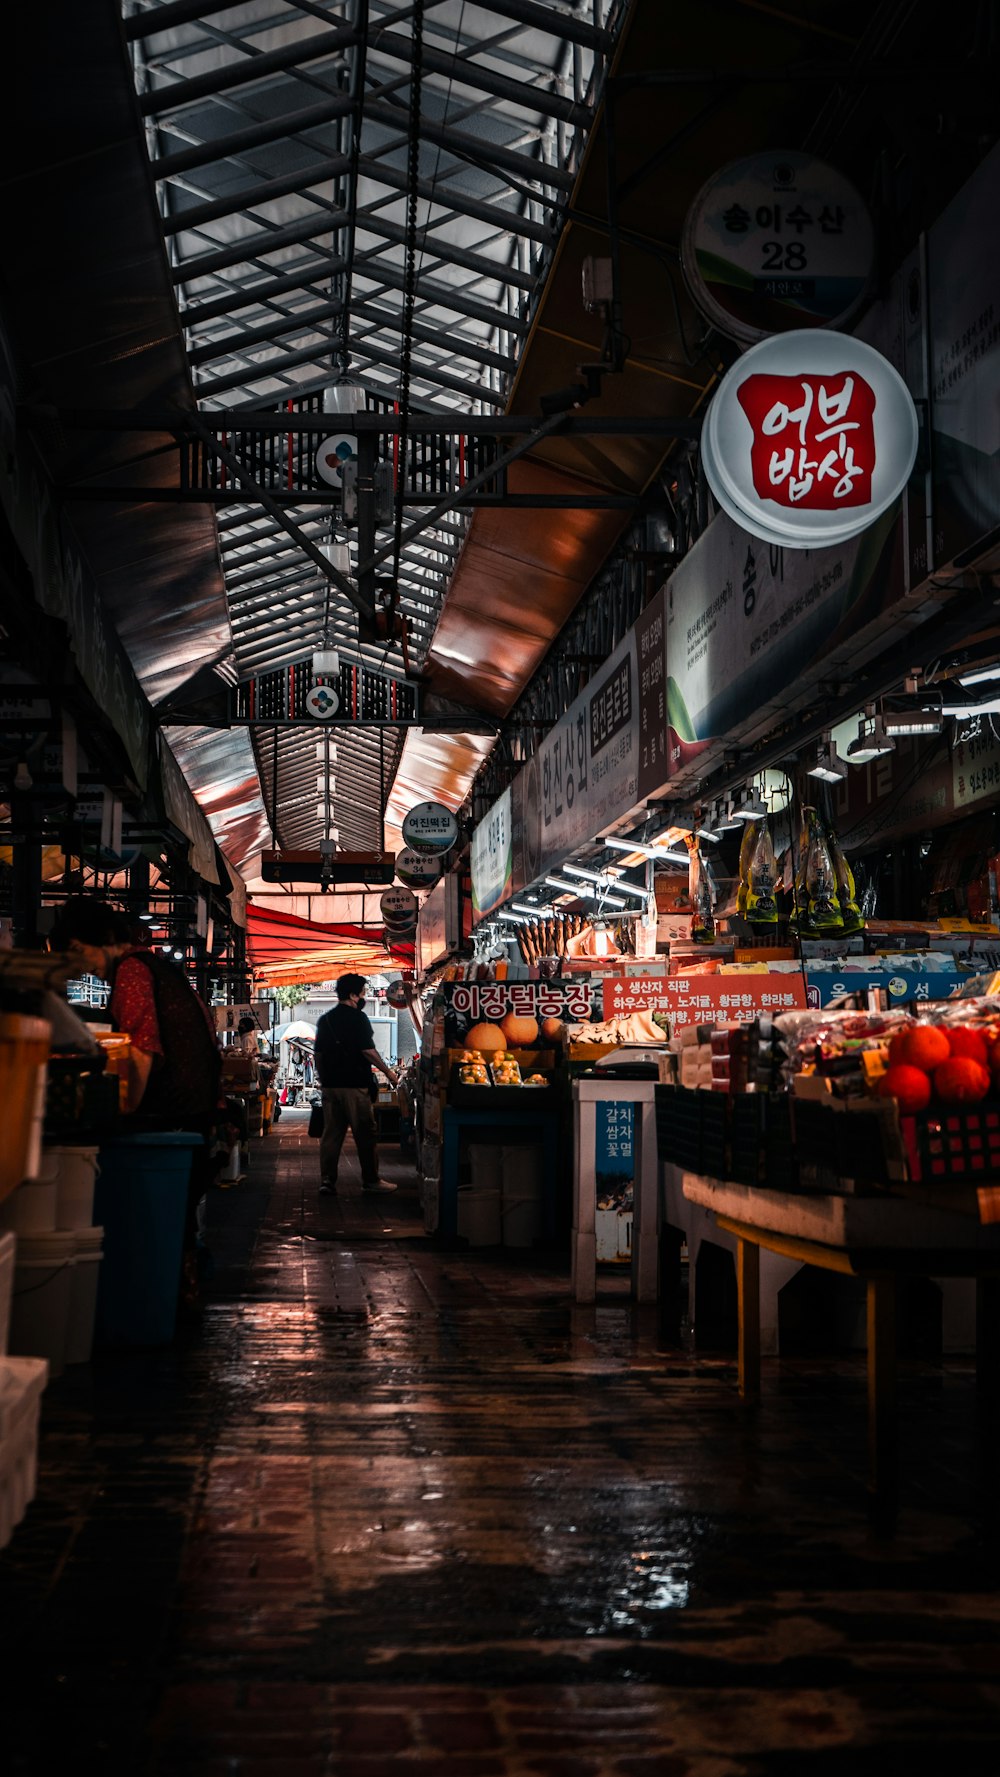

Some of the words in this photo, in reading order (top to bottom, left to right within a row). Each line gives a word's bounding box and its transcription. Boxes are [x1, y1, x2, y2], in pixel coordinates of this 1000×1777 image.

[723, 203, 845, 233] 송이수산
[762, 242, 807, 270] 28
[761, 376, 861, 446] 어부
[768, 432, 864, 502] 밥상
[591, 664, 629, 748] 한진글로벌
[543, 701, 588, 827] 한진상회
[409, 817, 450, 829] 여진떡집
[452, 983, 594, 1018] 이장털농장
[613, 996, 672, 1010] 하우스감귤,
[677, 995, 715, 1009] 노지귤,
[719, 994, 756, 1008] 황금향,
[761, 993, 798, 1007] 한라봉,
[629, 981, 663, 994] 생산자
[667, 980, 690, 993] 직판
[694, 1010, 731, 1023] 카라향,
[606, 1108, 632, 1124] 갈치
